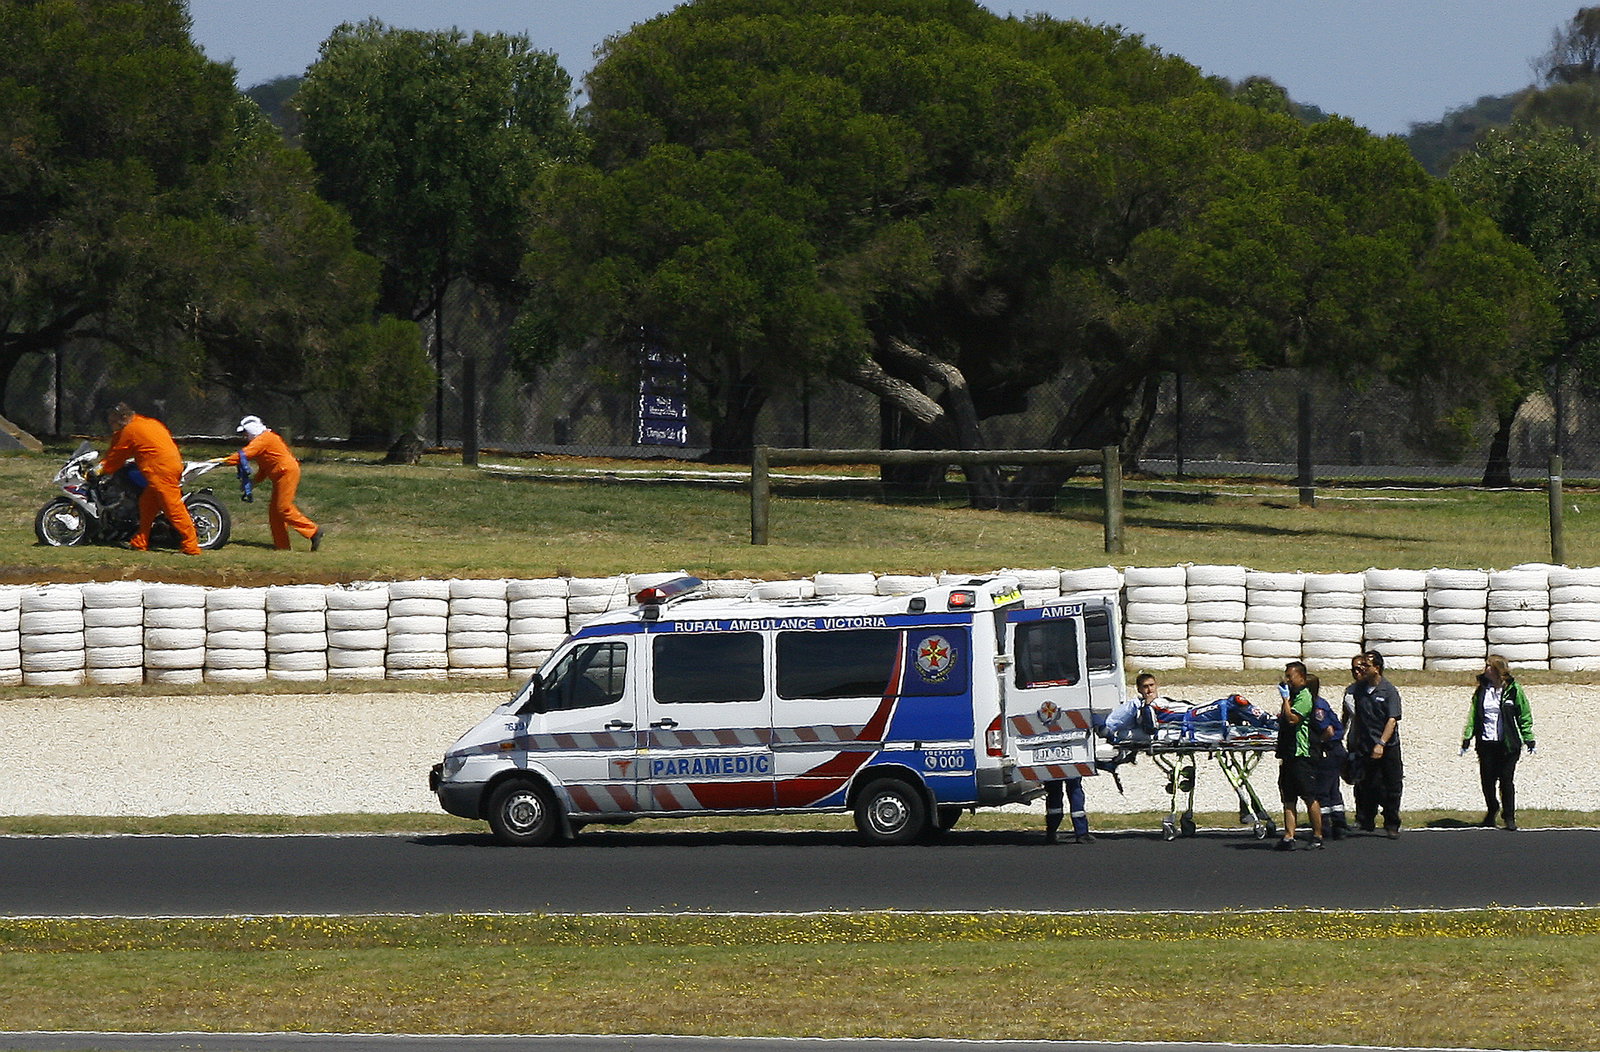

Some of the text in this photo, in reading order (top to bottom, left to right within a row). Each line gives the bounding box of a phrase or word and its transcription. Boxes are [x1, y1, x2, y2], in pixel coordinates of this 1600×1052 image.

[1041, 604, 1083, 618] AMBU
[674, 617, 887, 632] RURAL AMBULANCE VICTORIA
[653, 755, 769, 776] PARAMEDIC
